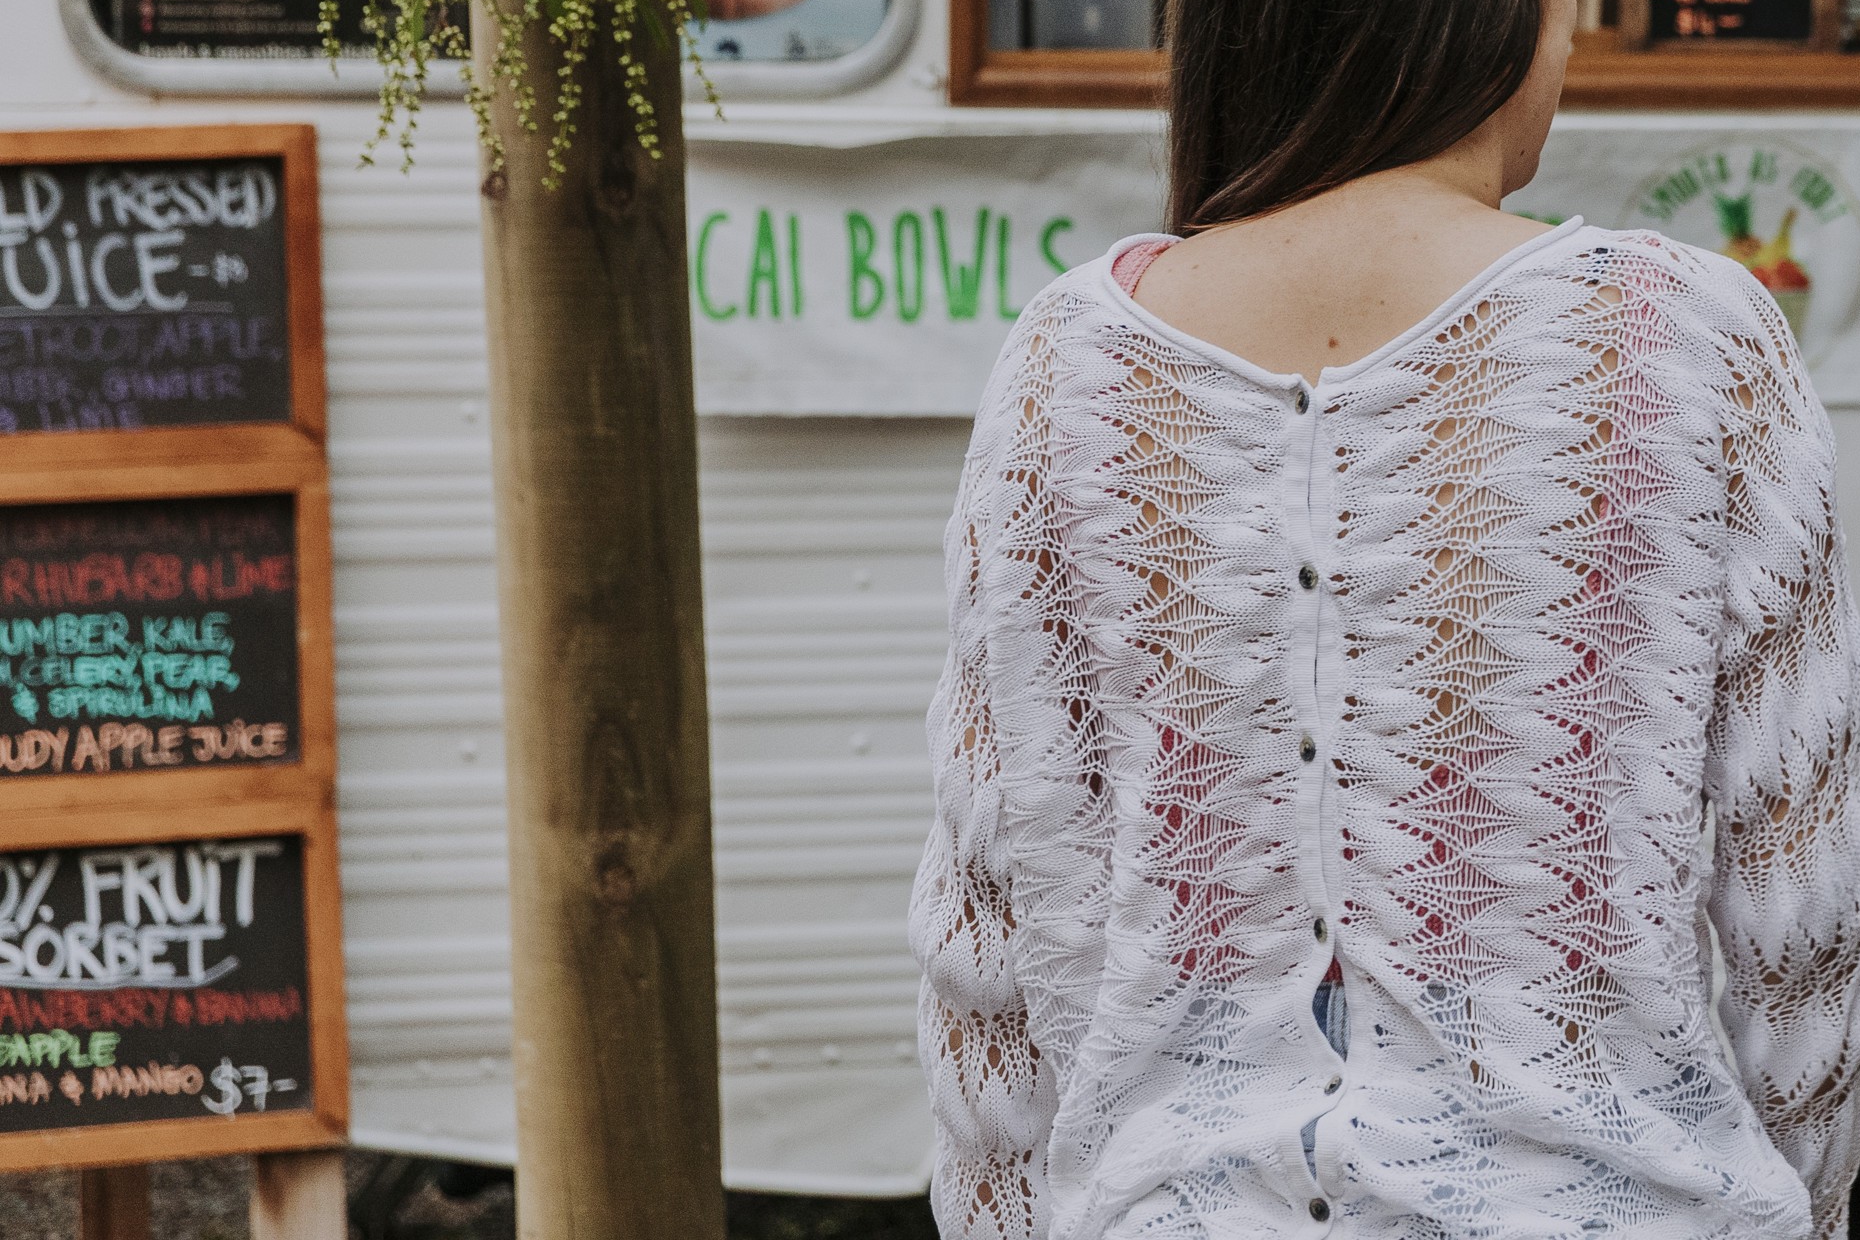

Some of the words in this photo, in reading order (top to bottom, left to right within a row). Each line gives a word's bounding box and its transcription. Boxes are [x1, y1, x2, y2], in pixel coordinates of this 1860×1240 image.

[844, 204, 1075, 324] BOWLS
[71, 722, 184, 772] APPLE
[187, 717, 289, 762] JUICE
[79, 839, 284, 935] FRUIT
